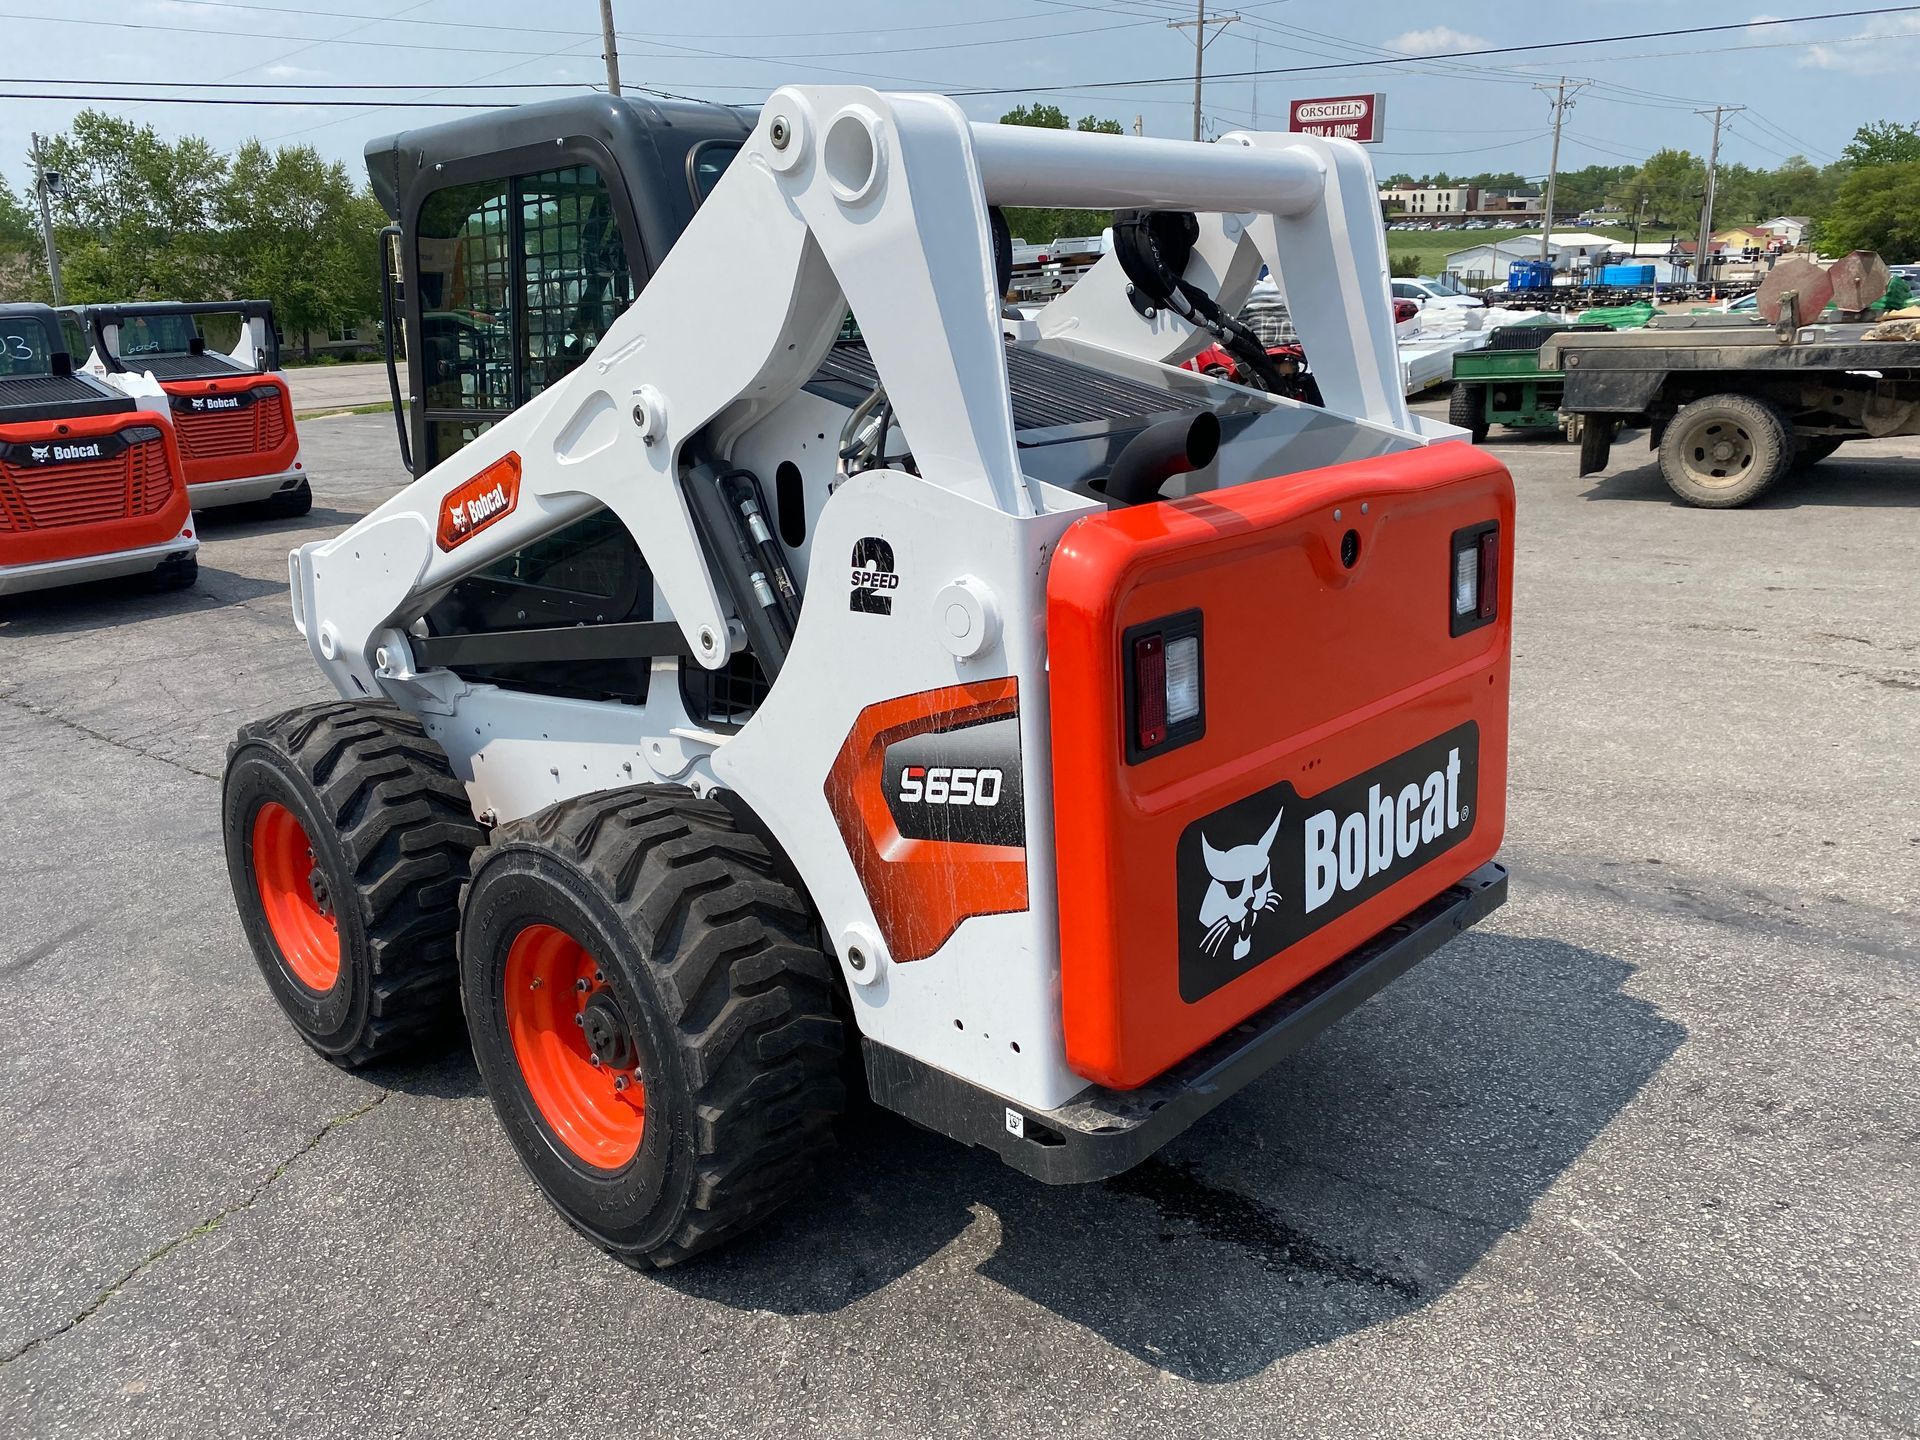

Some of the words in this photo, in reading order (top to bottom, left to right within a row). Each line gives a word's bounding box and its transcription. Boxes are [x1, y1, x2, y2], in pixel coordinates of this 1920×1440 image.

[1300, 103, 1362, 118] ORSCHELN
[1325, 127, 1333, 138] &
[1334, 124, 1359, 138] HOME
[206, 396, 238, 409] Bobcat
[53, 442, 100, 460] Bobcat
[467, 482, 507, 524] Bobcat
[850, 570, 899, 590] SPEED
[899, 767, 1003, 806] S650
